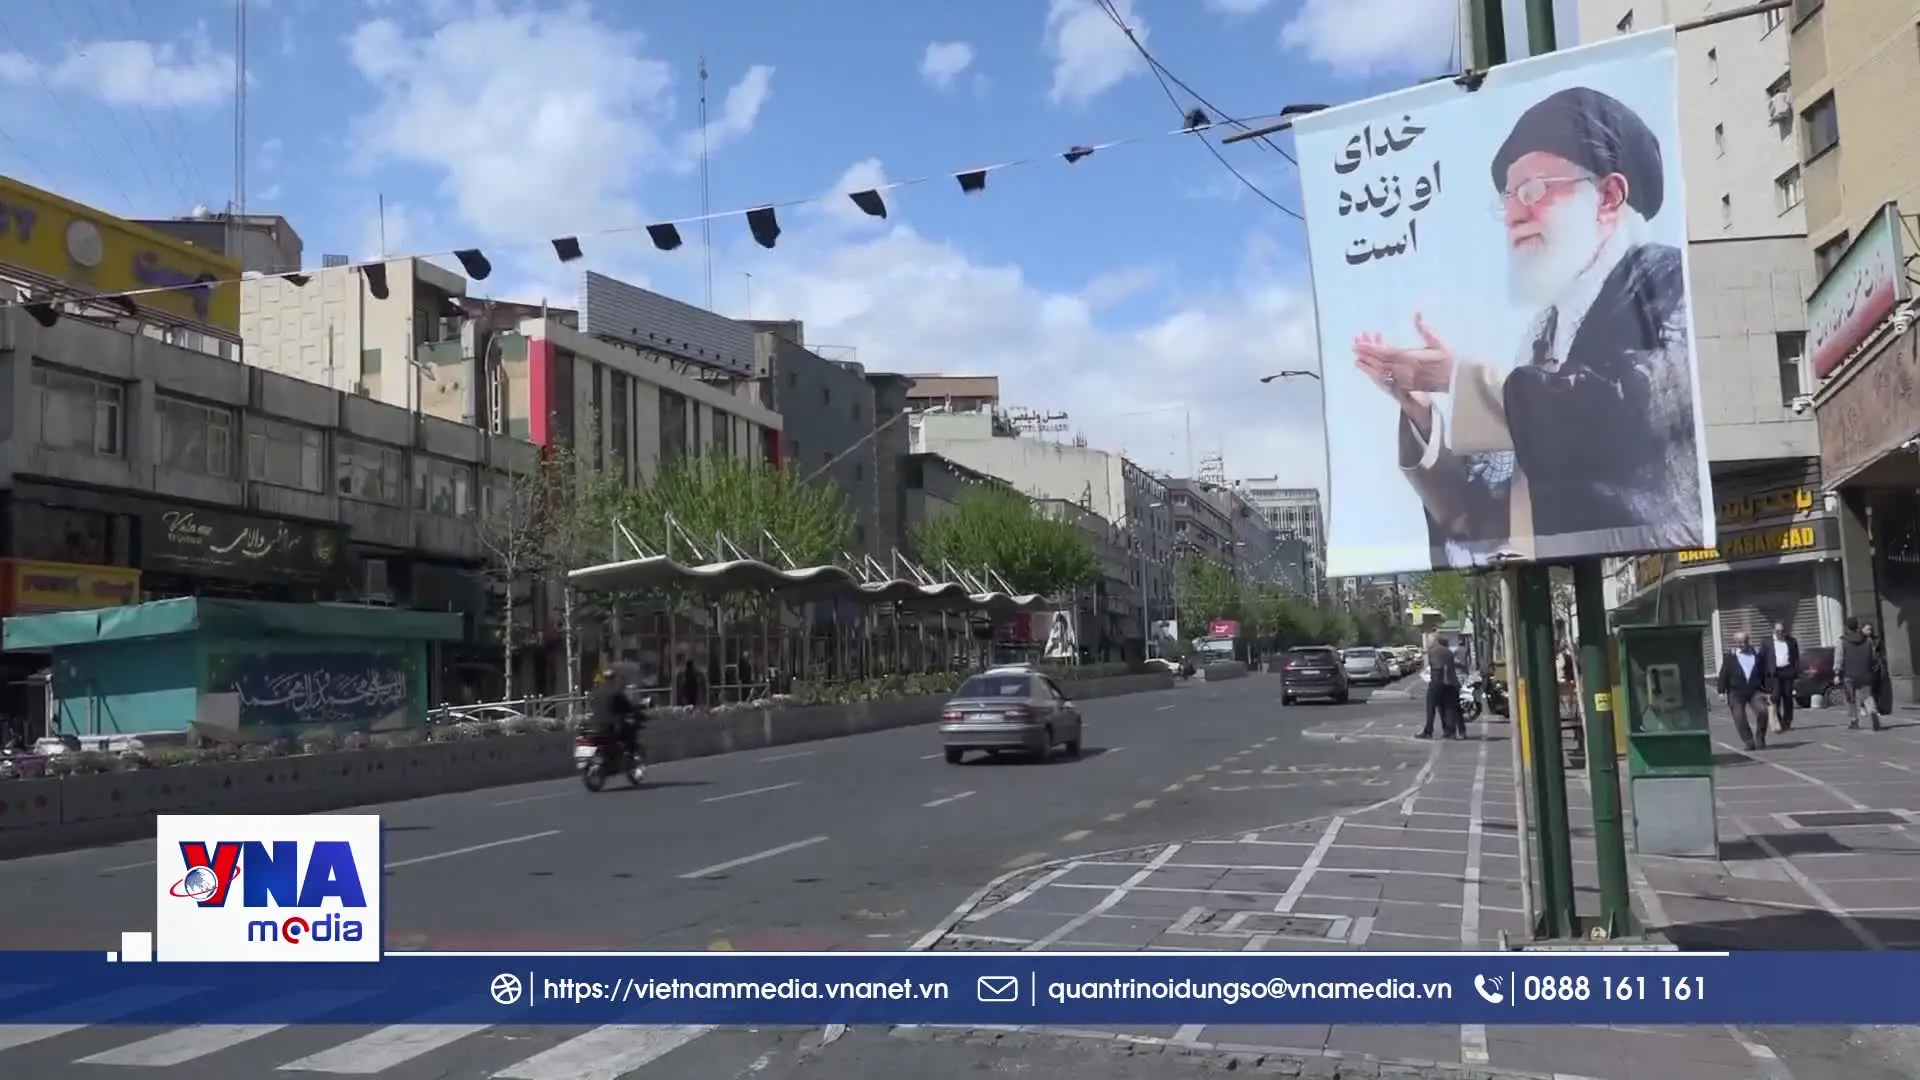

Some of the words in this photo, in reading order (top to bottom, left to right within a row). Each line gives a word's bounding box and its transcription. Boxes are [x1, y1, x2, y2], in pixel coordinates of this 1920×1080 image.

[1334, 115, 1427, 174] خدای
[1338, 175, 1401, 217] زنده
[1408, 160, 1441, 212] او
[1344, 217, 1417, 265] است
